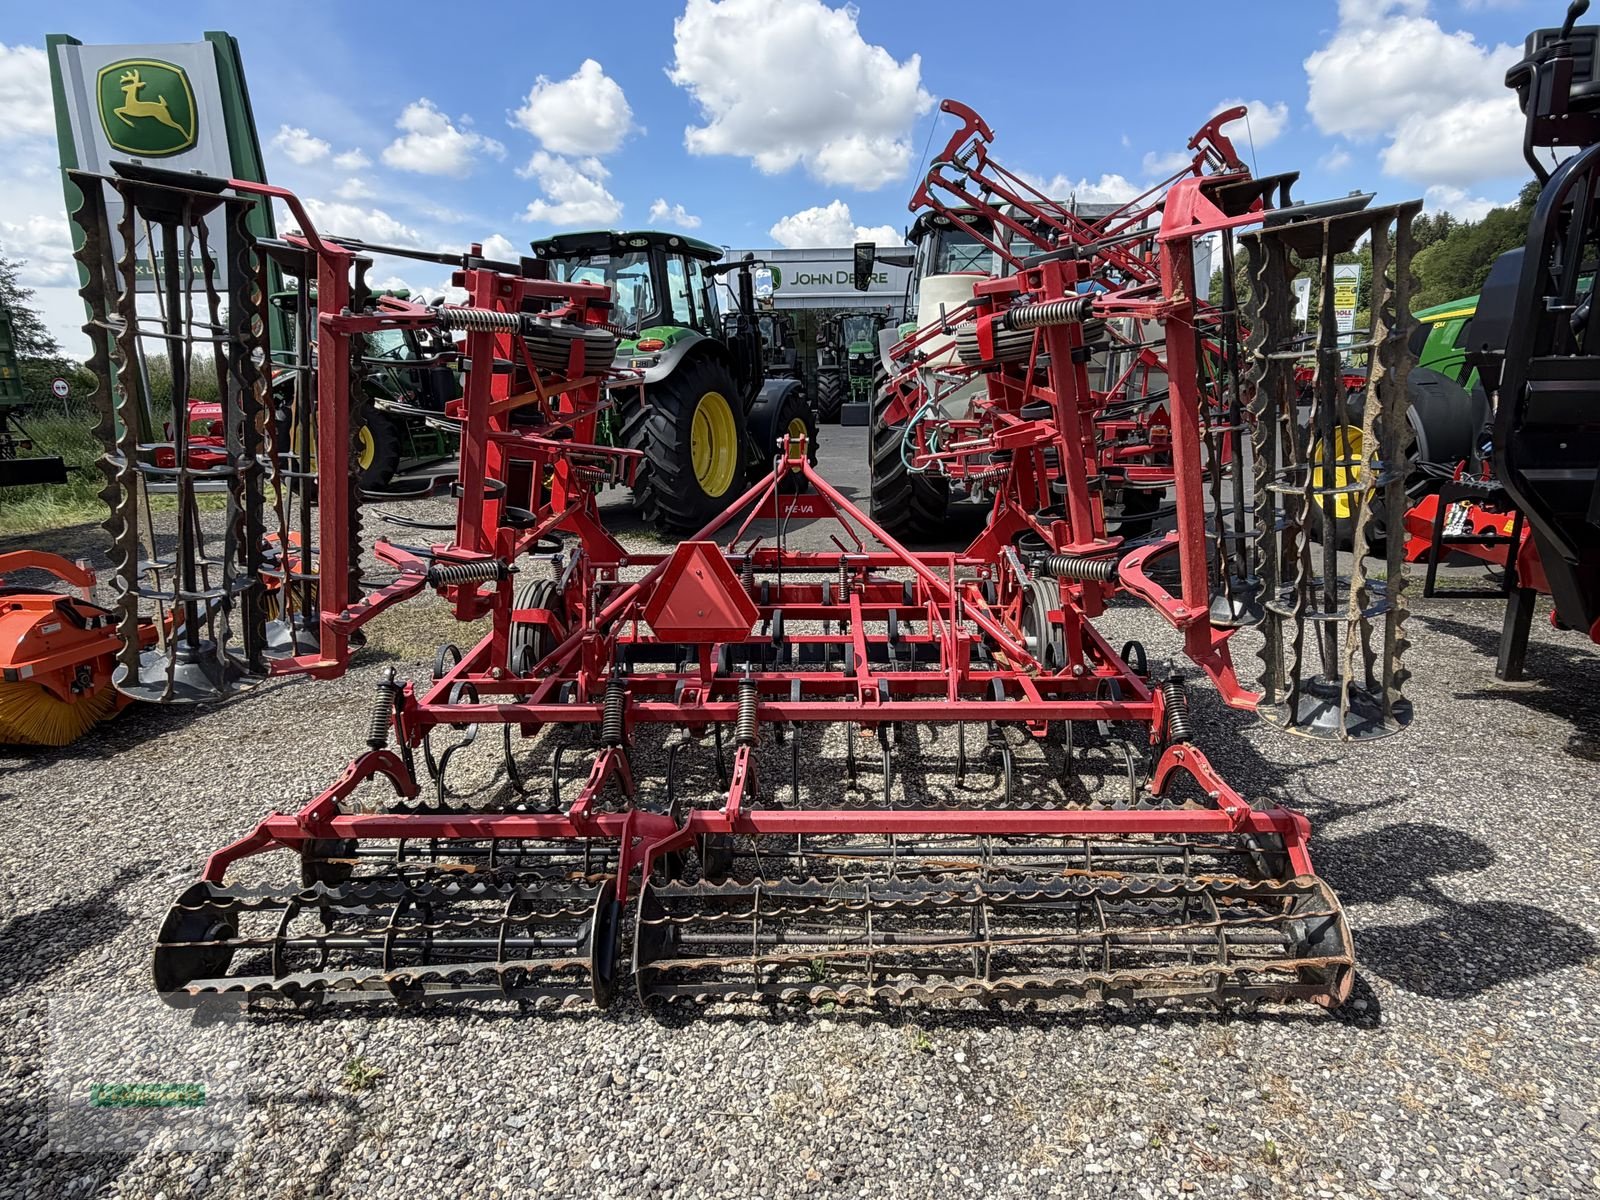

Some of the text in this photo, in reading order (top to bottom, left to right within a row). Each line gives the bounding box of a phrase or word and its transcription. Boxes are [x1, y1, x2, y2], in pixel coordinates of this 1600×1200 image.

[790, 271, 888, 285] JOHN DERE
[784, 505, 814, 513] HE-VA
